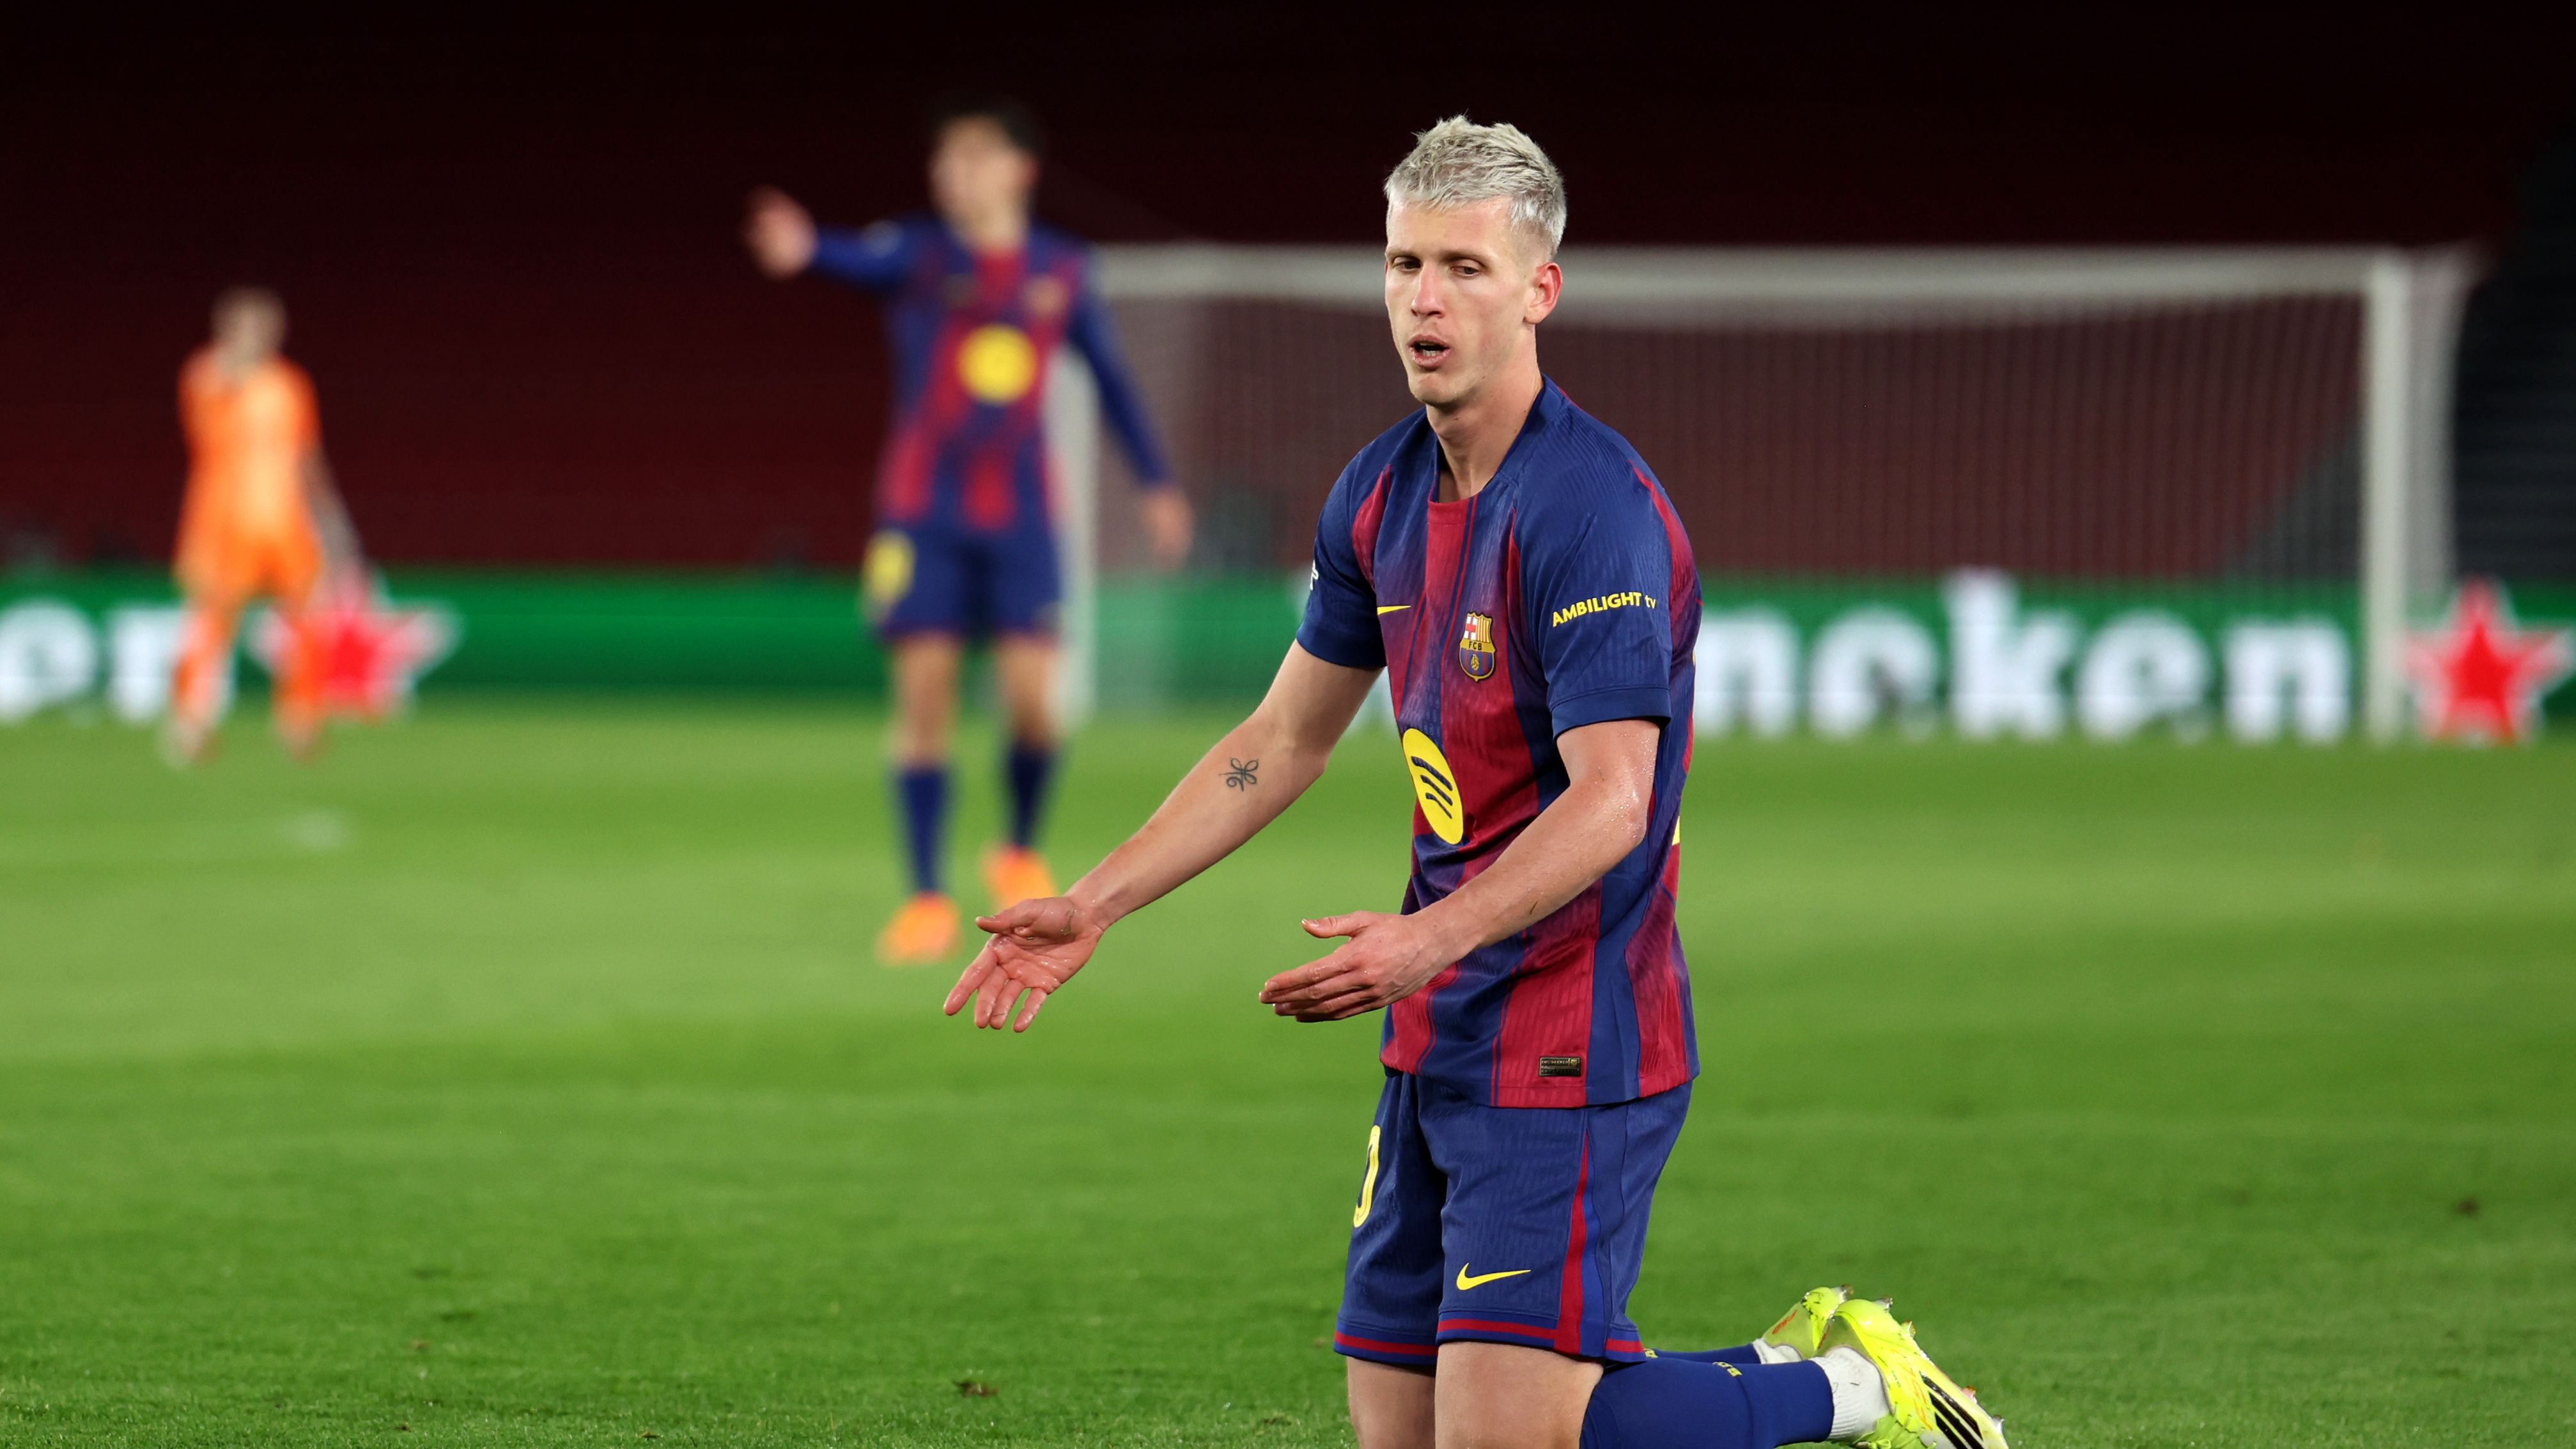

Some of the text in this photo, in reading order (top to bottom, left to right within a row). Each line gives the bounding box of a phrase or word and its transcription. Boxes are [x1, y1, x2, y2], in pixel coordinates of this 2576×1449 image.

[1553, 593, 1656, 627] AMBILIGHT tv
[1468, 640, 1482, 651] FCB
